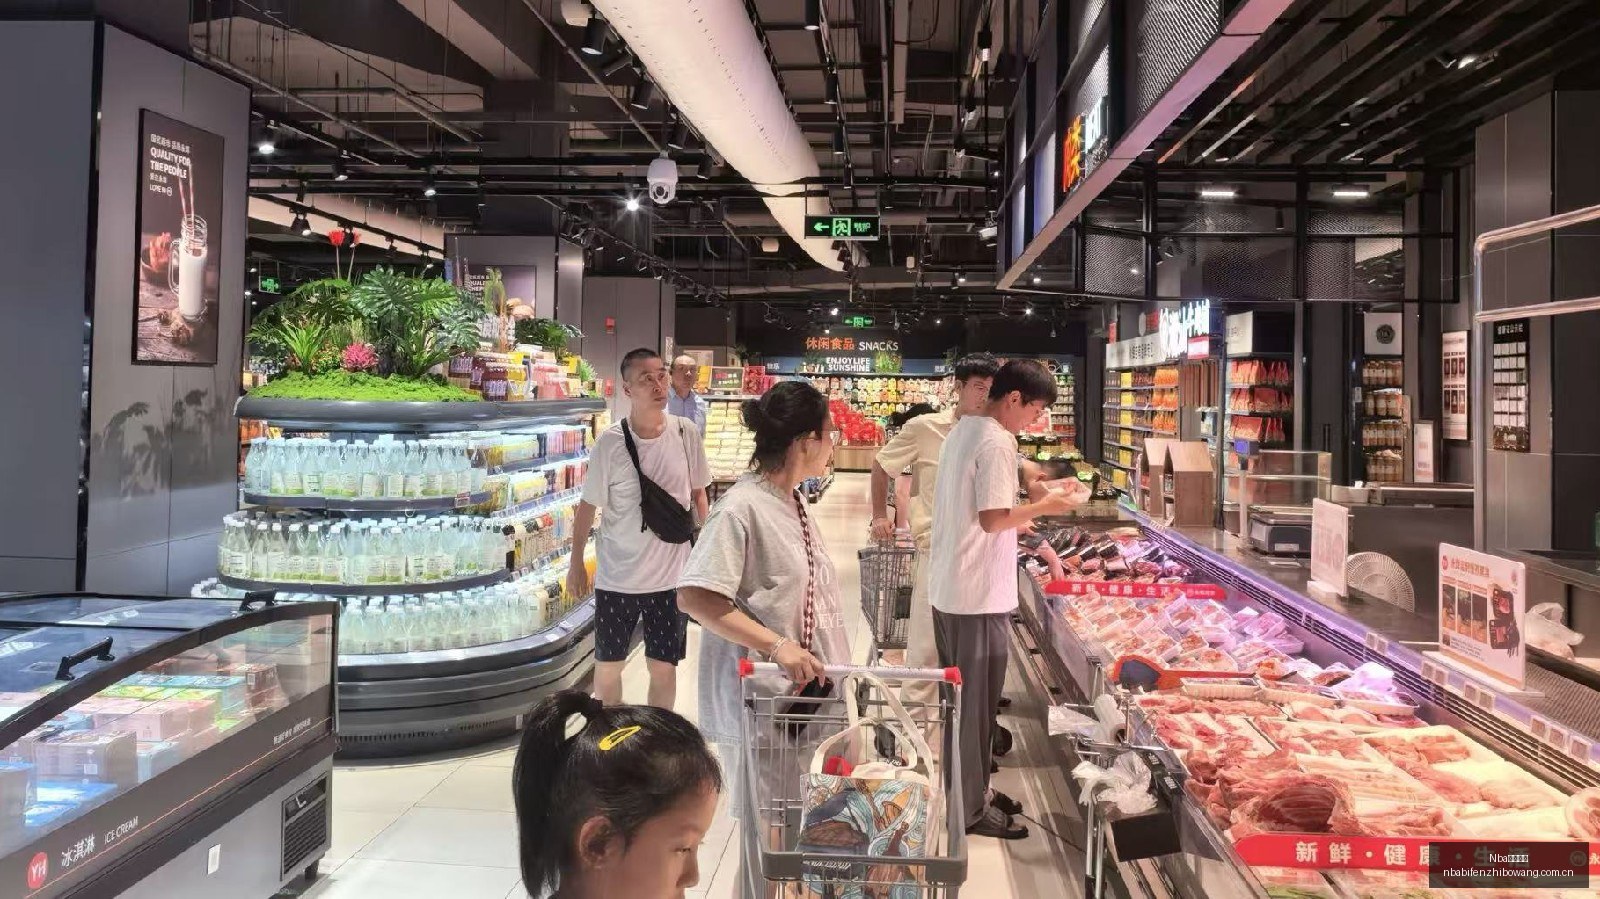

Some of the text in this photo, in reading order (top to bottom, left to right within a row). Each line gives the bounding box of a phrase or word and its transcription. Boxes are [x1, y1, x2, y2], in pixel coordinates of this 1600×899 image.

[150, 147, 191, 167] QUALITY FOR
[150, 160, 164, 172] THE
[163, 162, 187, 179] PEOPLE
[806, 337, 855, 350] 休闲食品
[858, 340, 899, 351] SNACKS
[826, 357, 870, 365] ENJOY LIFE
[828, 364, 870, 372] SUNSHINE
[104, 815, 138, 844] ICE CREAM
[61, 832, 95, 866] 冰淇淋
